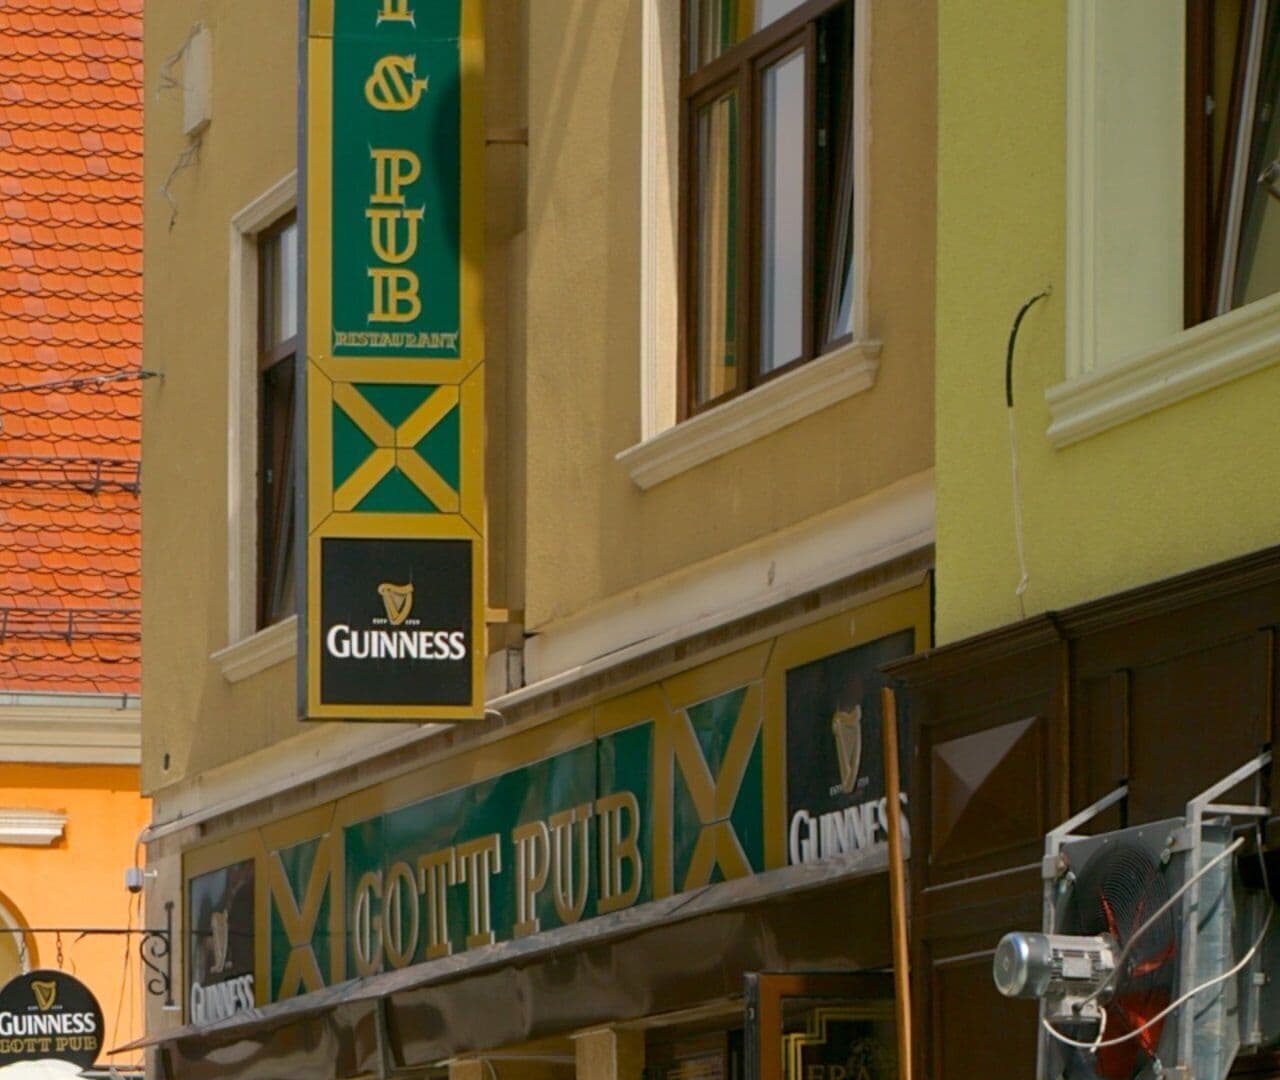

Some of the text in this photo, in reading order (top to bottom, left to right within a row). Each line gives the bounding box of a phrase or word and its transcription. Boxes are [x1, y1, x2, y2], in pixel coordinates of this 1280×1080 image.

[365, 54, 429, 112] &
[365, 143, 426, 328] PUB
[333, 328, 459, 352] RESTAURANT
[327, 624, 466, 660] GUINNESS
[352, 790, 643, 978] GOTT PUB
[55, 1036, 98, 1052] PUB
